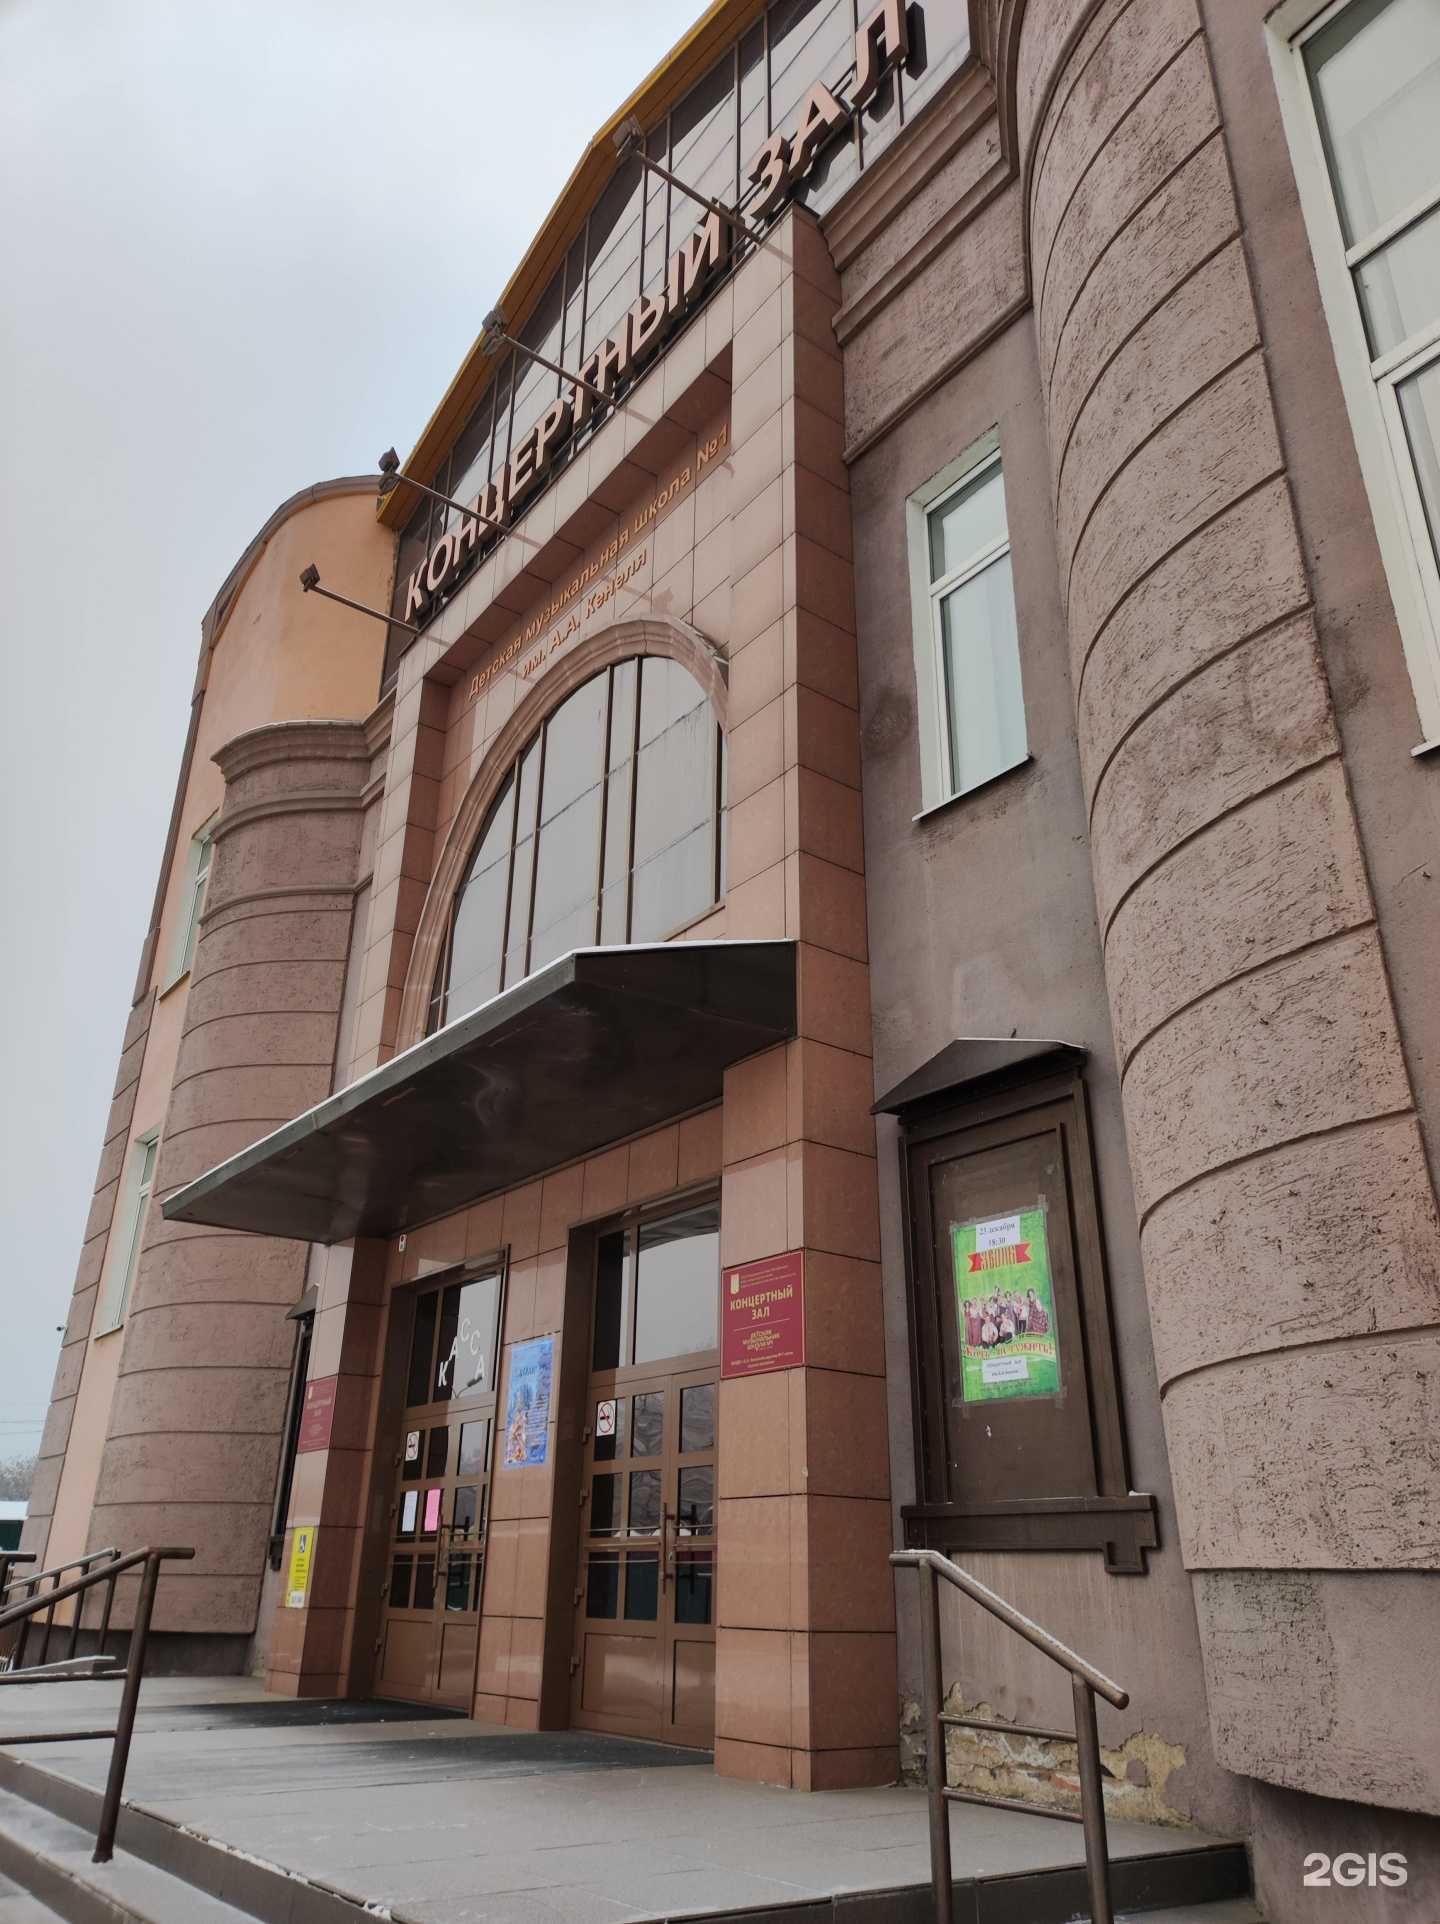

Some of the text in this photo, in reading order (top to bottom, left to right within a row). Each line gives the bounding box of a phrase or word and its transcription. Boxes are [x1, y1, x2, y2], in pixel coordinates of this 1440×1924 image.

[404, 0, 908, 622] КОНЦЕРТНЫЙ ЗАЛ
[468, 423, 728, 702] Детская музыкальная школа №1
[585, 548, 648, 620] Кенеля
[730, 1283, 793, 1311] КОНЦЕРТНЫЙ
[751, 1306, 770, 1320] ЗАЛ
[438, 1318, 487, 1387] КАССА
